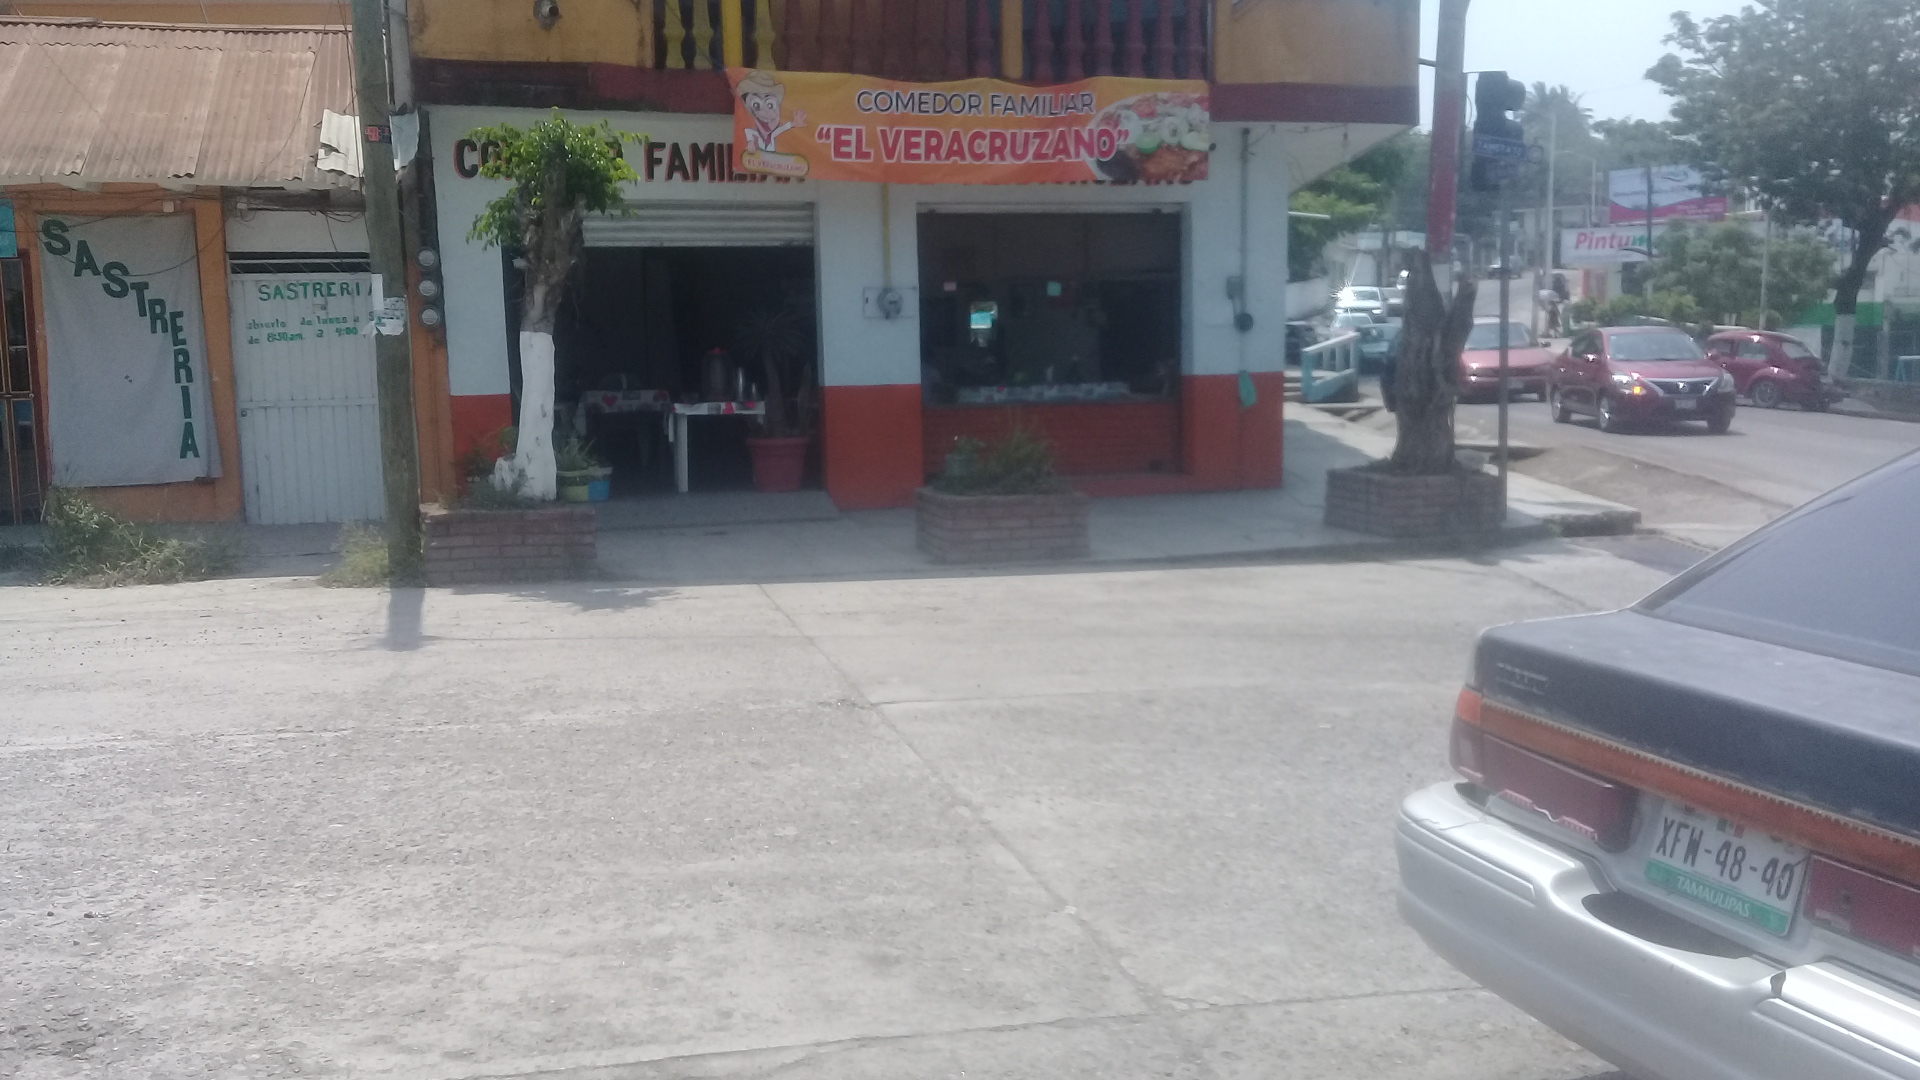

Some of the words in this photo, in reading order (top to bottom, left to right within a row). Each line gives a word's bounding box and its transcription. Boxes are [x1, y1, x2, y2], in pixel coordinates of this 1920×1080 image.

[856, 90, 982, 116] COMEDOR
[989, 91, 1095, 117] FAMILIAR
[645, 141, 805, 184] FAMIL
[41, 218, 200, 460] SASTRERIA
[1676, 875, 1751, 918] TAMAULIPAS
